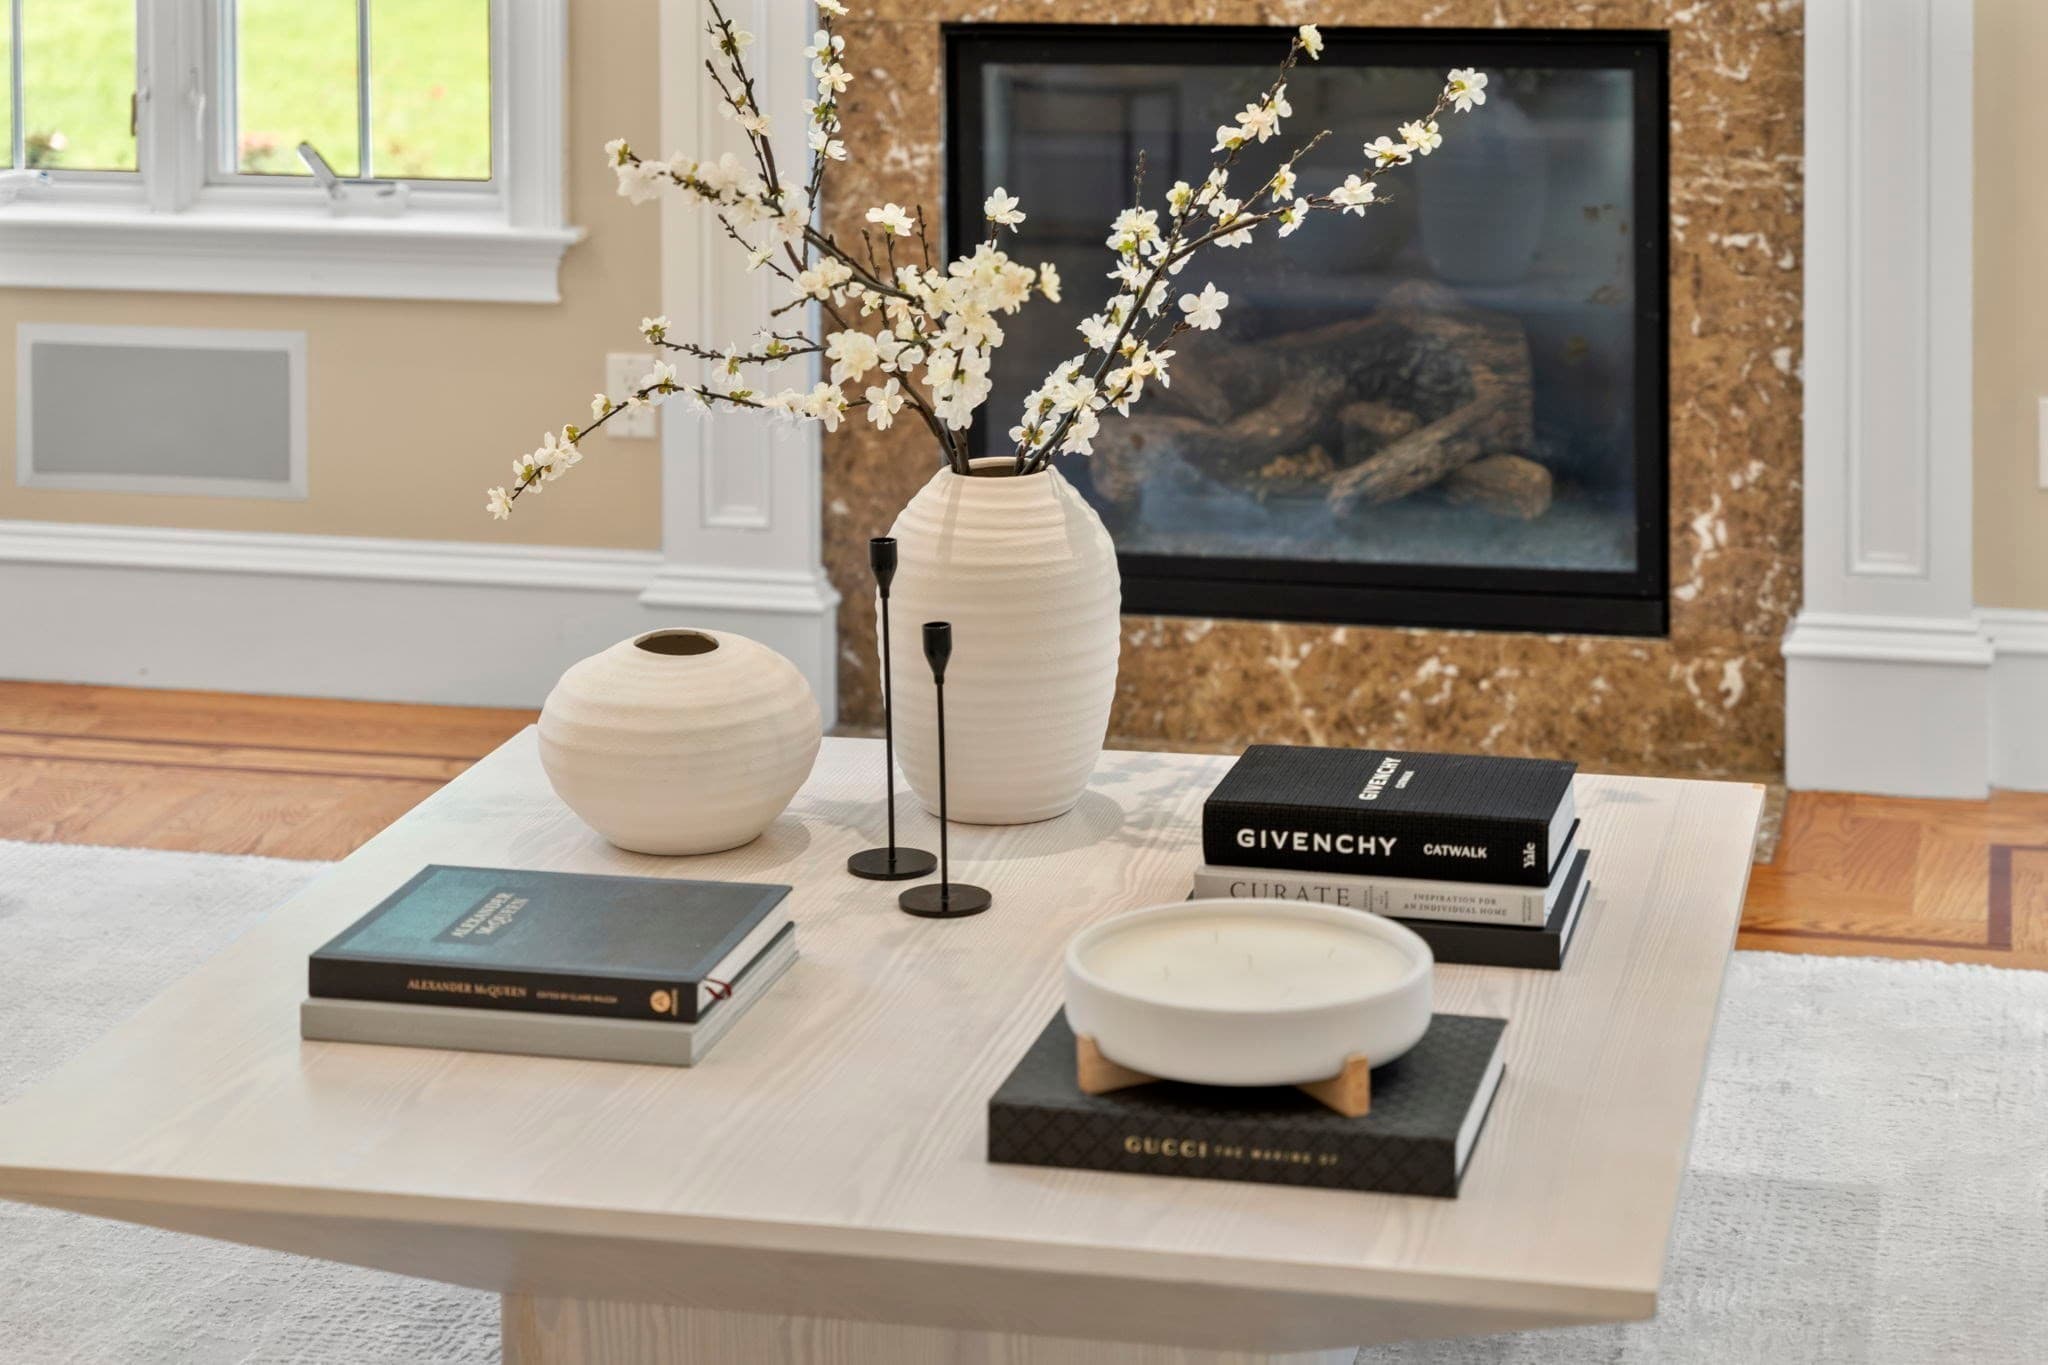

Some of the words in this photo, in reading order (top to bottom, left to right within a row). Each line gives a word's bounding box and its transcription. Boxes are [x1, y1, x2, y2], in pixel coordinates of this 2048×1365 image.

[1237, 828, 1398, 856] GIVENCHY
[1423, 843, 1488, 859] CATWALK
[1523, 842, 1536, 869] Yale
[1229, 881, 1351, 908] CURATE
[1413, 893, 1475, 906] INSPIRATION
[1478, 898, 1497, 906] FOR
[451, 892, 516, 938] ALEXANDER
[1403, 903, 1416, 911] AN
[1419, 904, 1476, 915] INDIVIDUAL
[1480, 907, 1508, 917] HOME
[406, 979, 473, 995] ALEXANDER
[474, 984, 527, 999] McQUEEN
[1124, 1135, 1208, 1160] GUCCI
[1213, 1143, 1243, 1160] THE
[1318, 1152, 1338, 1167] OF
